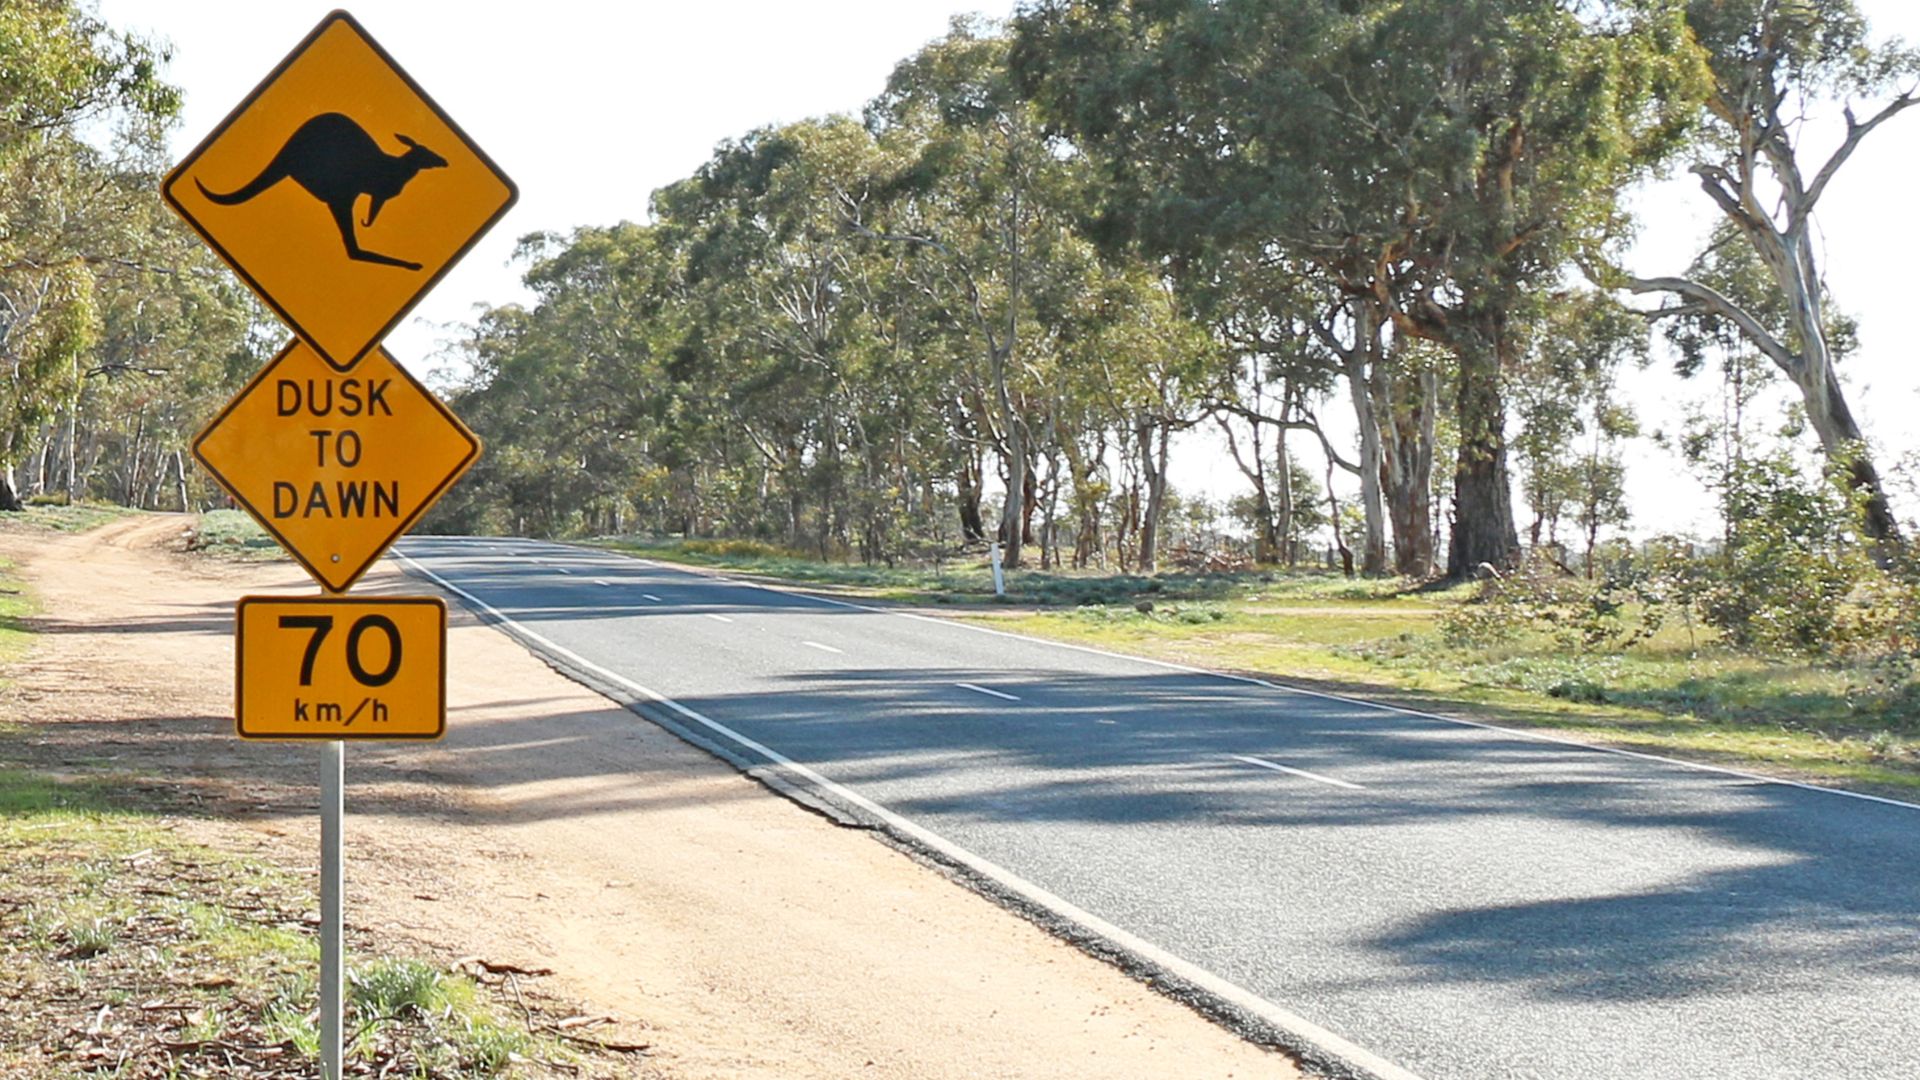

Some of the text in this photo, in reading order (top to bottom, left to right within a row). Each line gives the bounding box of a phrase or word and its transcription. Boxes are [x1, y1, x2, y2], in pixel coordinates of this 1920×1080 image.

[277, 379, 392, 417] DUSK
[309, 430, 362, 468] TO
[273, 481, 399, 519] DAWN
[278, 614, 403, 688] 70
[294, 698, 388, 727] km/h
